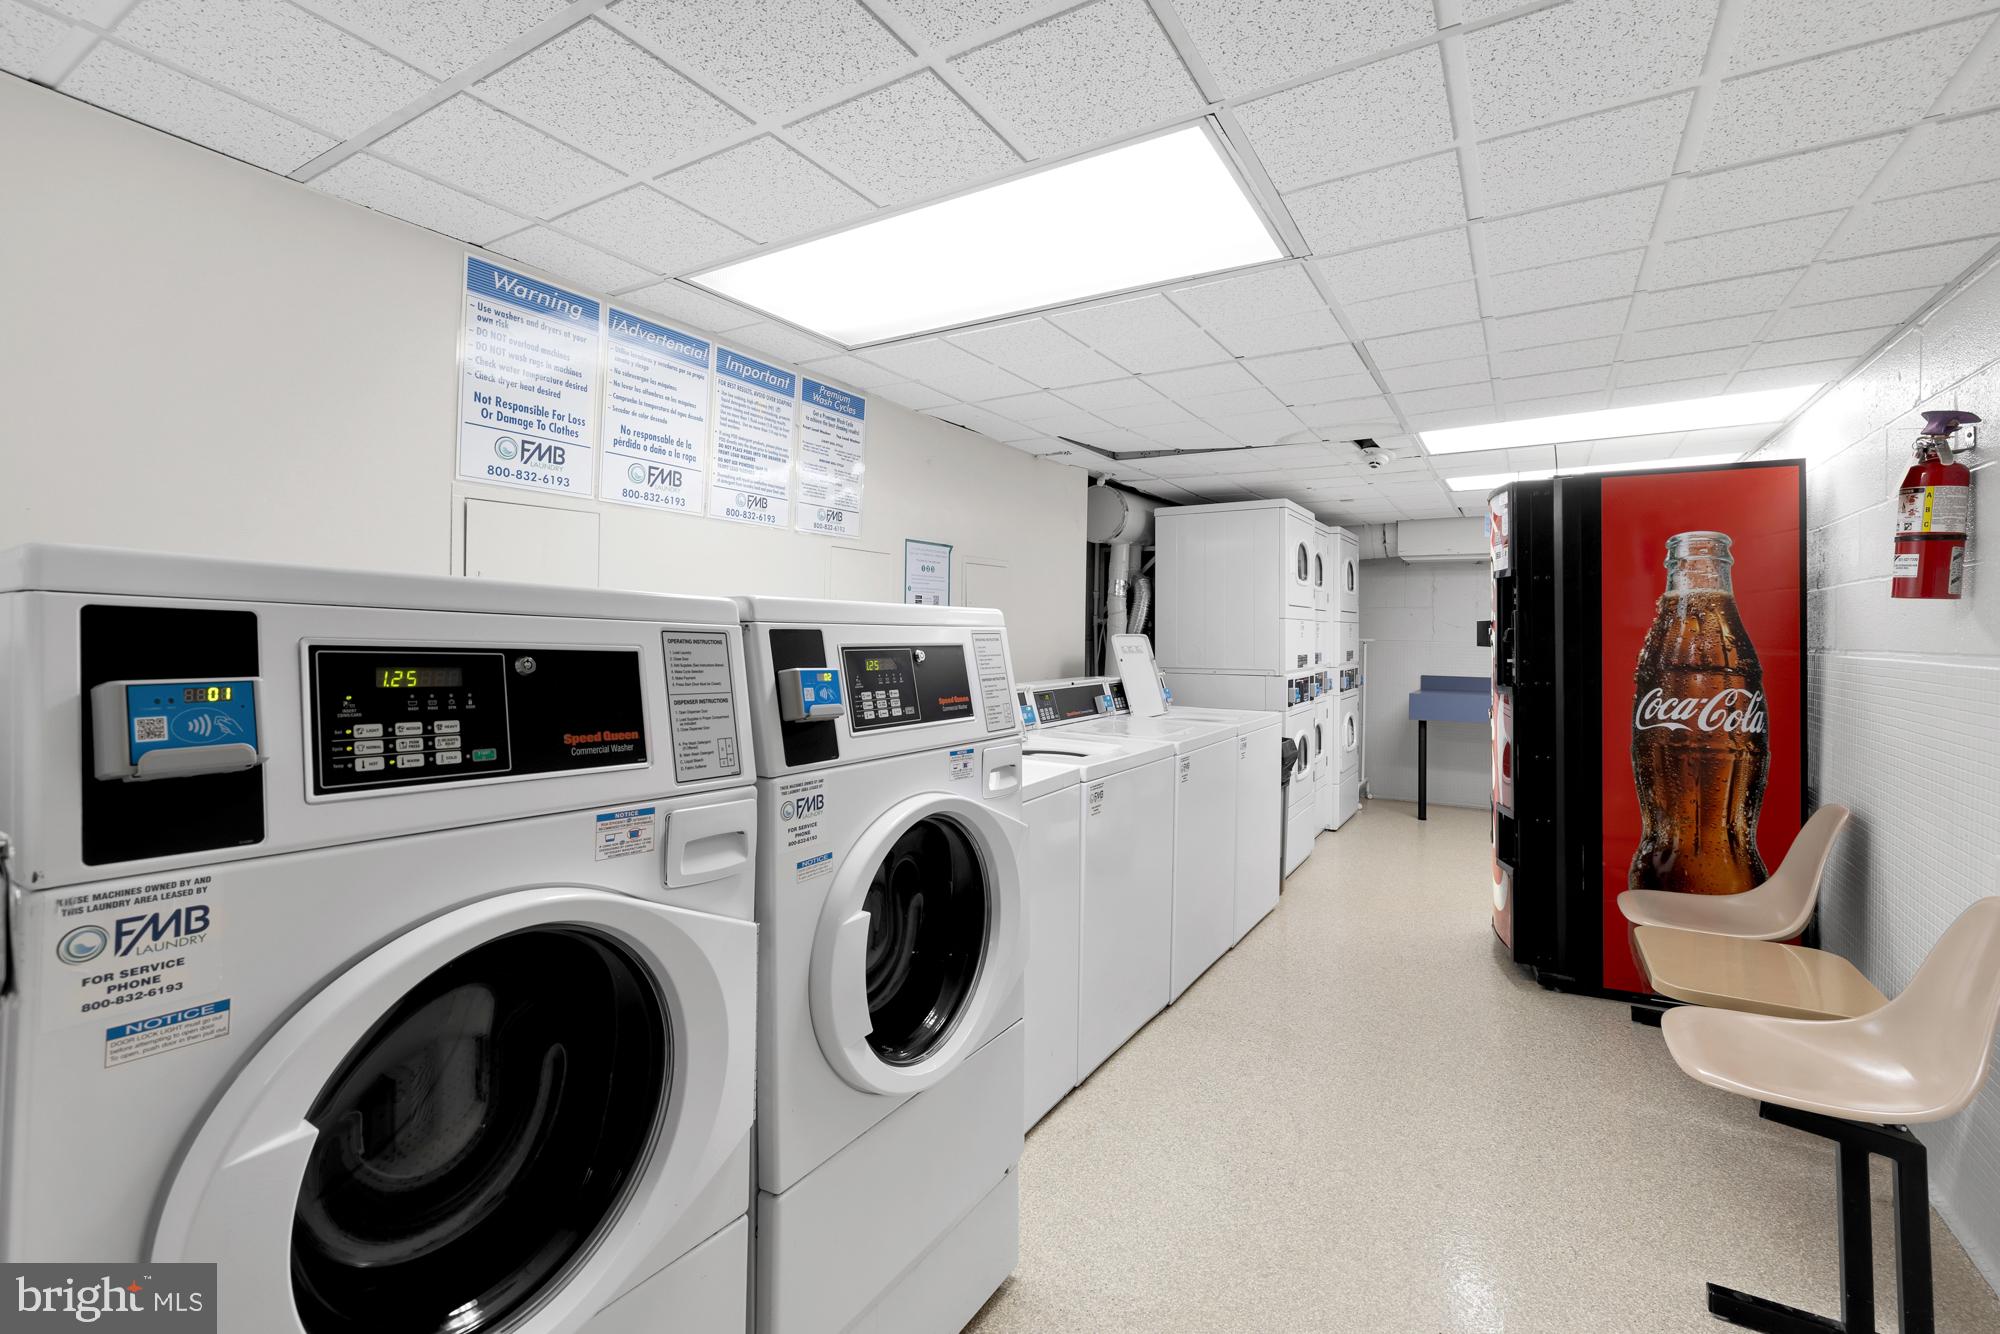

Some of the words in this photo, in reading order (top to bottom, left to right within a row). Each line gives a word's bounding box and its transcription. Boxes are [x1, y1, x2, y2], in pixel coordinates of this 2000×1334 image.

[494, 271, 582, 320] Warning
[477, 315, 494, 325] own
[495, 319, 509, 329] risk
[477, 302, 492, 314] Use
[494, 309, 524, 324] washers
[526, 319, 539, 329] and
[540, 321, 562, 336] dryers
[572, 334, 587, 343] your
[476, 326, 488, 337] DO
[490, 330, 507, 343] NOT
[509, 337, 539, 353] overload
[540, 346, 570, 361] machines
[476, 341, 487, 352] DO
[489, 345, 506, 358] NOT
[508, 351, 527, 363] wash
[529, 356, 544, 368] rugs
[546, 360, 552, 369] in
[553, 365, 583, 378] machines
[475, 356, 496, 368] Check
[499, 363, 520, 375] water
[522, 367, 564, 386] temperature
[565, 379, 588, 393] desired
[725, 355, 790, 390] Important
[474, 370, 496, 383] Check
[498, 375, 518, 389] dryer
[520, 381, 535, 393] heat
[537, 385, 561, 399] desired
[718, 379, 727, 387] FOR
[727, 382, 736, 390] BEST
[820, 385, 851, 403] Premium
[474, 391, 492, 405] Not
[495, 396, 550, 419] Responsible
[552, 409, 566, 421] For
[568, 413, 586, 427] Loss
[813, 392, 833, 407] Wash
[834, 400, 856, 415] Cycles
[480, 407, 493, 420] Or
[496, 411, 534, 431] Damage
[537, 419, 546, 431] To
[548, 422, 579, 438] Clothes
[620, 424, 631, 436] No
[633, 430, 674, 446] responsable
[676, 438, 684, 448] de
[686, 440, 692, 450] la
[520, 439, 566, 466] FMB
[613, 436, 641, 450] pérdida
[649, 444, 667, 456] daño
[674, 449, 680, 459] la
[682, 453, 697, 463] ropa
[487, 464, 570, 488] 800-832-6193
[530, 461, 564, 472] LAUNDRY
[648, 465, 683, 488] FMB
[622, 488, 686, 507] 800-832-6193
[747, 494, 768, 509] FMB
[726, 508, 776, 523] 800-832-6193
[826, 509, 843, 522] FMB
[383, 670, 417, 687] 1.25
[823, 672, 832, 681] 02
[207, 687, 231, 702] 01
[938, 697, 954, 705] Speed
[1635, 687, 1764, 733] Coca-Cola
[563, 732, 602, 746] Speed
[603, 731, 639, 741] Queen
[571, 746, 609, 756] Commercial
[611, 744, 634, 752] Washer
[615, 810, 639, 819] NOTICE
[796, 794, 824, 819] FMB
[803, 810, 824, 819] LAUNDRY
[788, 826, 797, 834] FOR
[798, 821, 817, 831] SERVICE
[795, 830, 811, 838] PHONE
[788, 835, 817, 847] 800-832-6193
[801, 854, 829, 868] NOTICE
[92, 886, 142, 901] MACHINES
[144, 881, 177, 893] OWNED
[179, 879, 192, 888] BY
[194, 876, 212, 885] AND
[61, 907, 84, 917] THIS
[86, 899, 132, 913] LAUNDRY
[133, 895, 158, 906] AREA
[161, 888, 194, 901] LEASED
[196, 886, 209, 895] BY
[114, 904, 211, 958] FMB
[136, 933, 207, 956] LAUNDRY
[81, 972, 115, 988] FOR
[119, 957, 185, 979] SERVICE
[106, 974, 162, 995] PHONE
[81, 982, 184, 1013] 800-832-6193
[125, 1004, 216, 1035] NOTICE
[110, 1037, 135, 1048] DOOR
[136, 1031, 158, 1042] LOCK
[160, 1025, 183, 1036] LIGHT
[184, 1020, 201, 1029] must
[202, 1017, 211, 1025] go
[110, 1045, 133, 1055] before
[134, 1035, 172, 1048] attempting
[181, 1027, 199, 1037] open
[200, 1023, 215, 1031] door
[142, 1043, 160, 1054] push
[161, 1039, 177, 1048] door
[187, 1032, 201, 1041] then
[202, 1028, 215, 1038] pull
